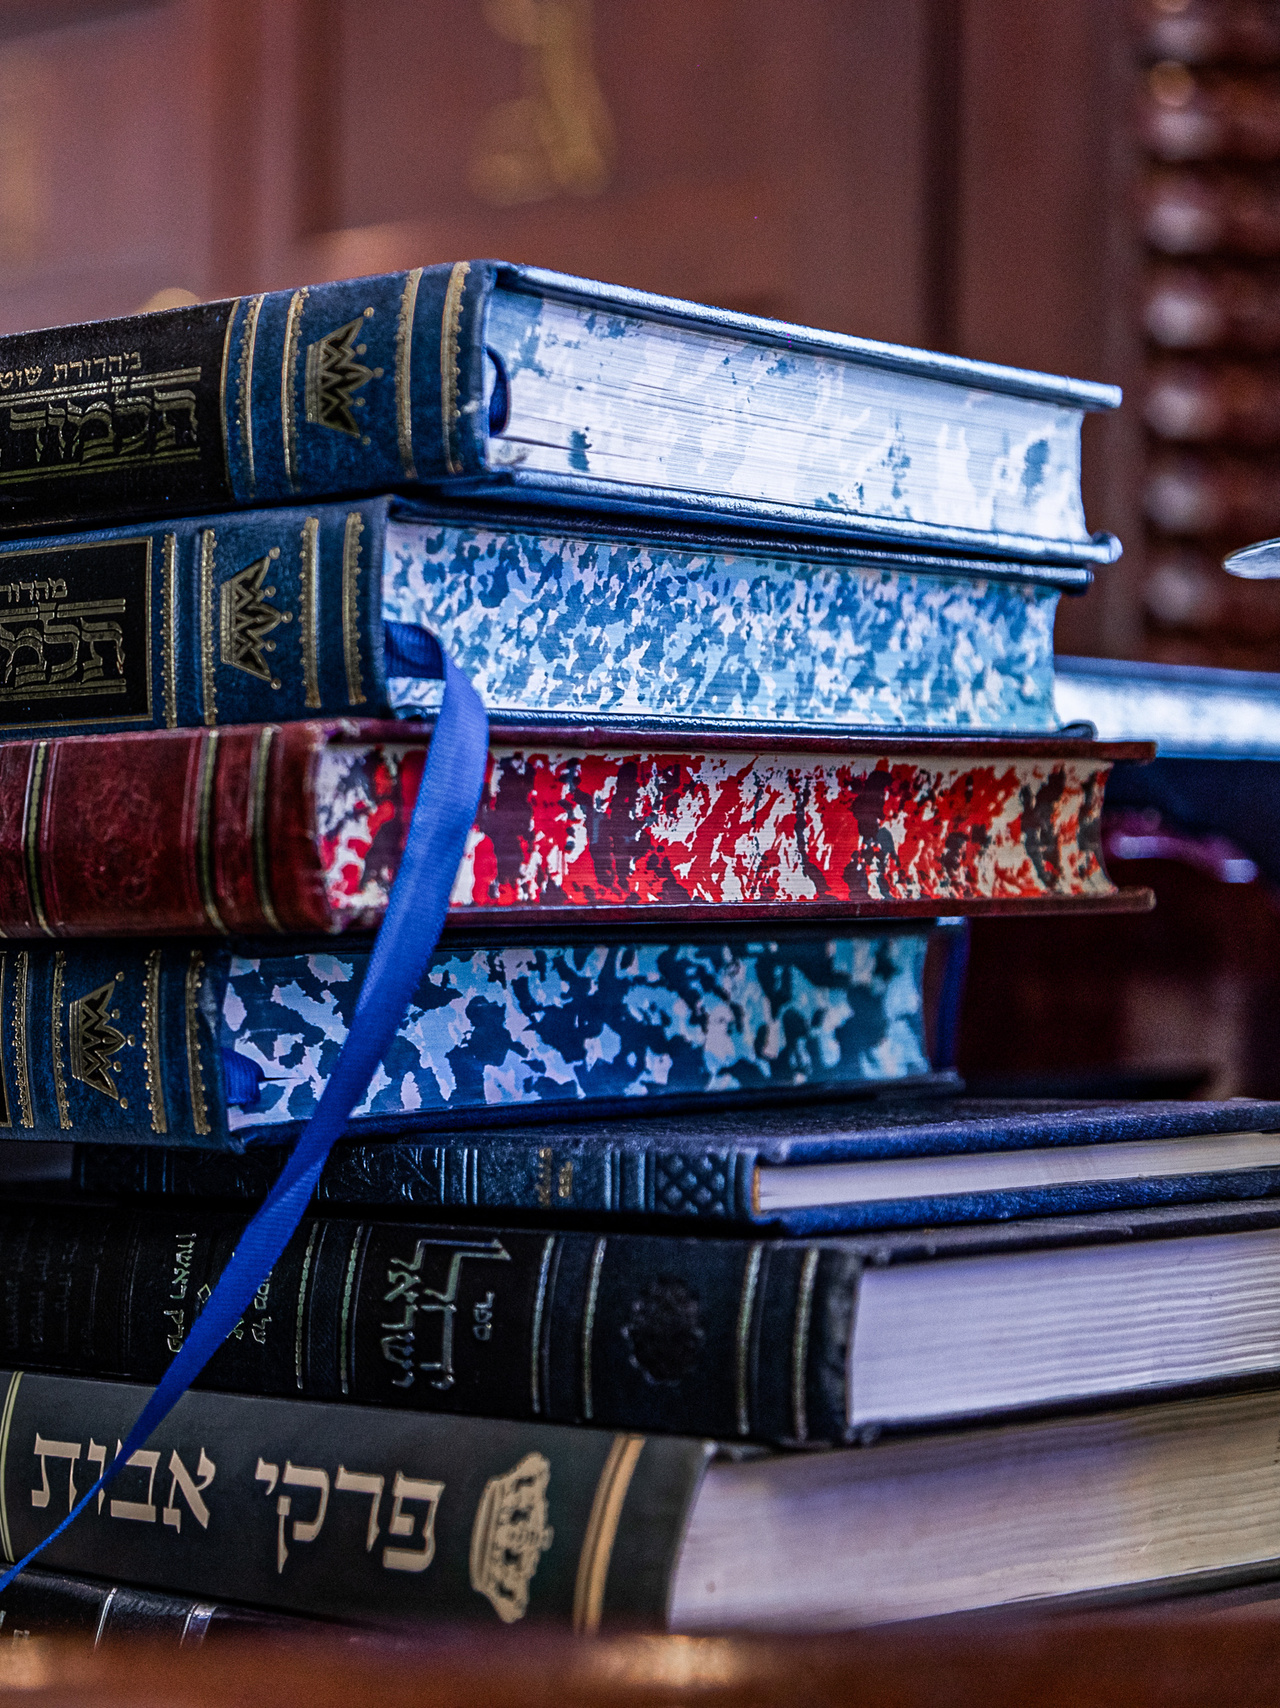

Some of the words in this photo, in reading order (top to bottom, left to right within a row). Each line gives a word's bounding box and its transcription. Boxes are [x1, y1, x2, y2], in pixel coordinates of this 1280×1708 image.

[52, 351, 141, 385] מהדורת
[9, 376, 199, 465] תלמוד
[169, 1232, 198, 1300] ראשון
[162, 1308, 185, 1354] פרק
[250, 1316, 273, 1345] על
[379, 1237, 504, 1390] ישראל
[419, 1238, 513, 1391] יחל
[471, 1289, 497, 1342] ספר
[30, 1431, 217, 1535] אבות
[255, 1456, 447, 1574] פרקי
